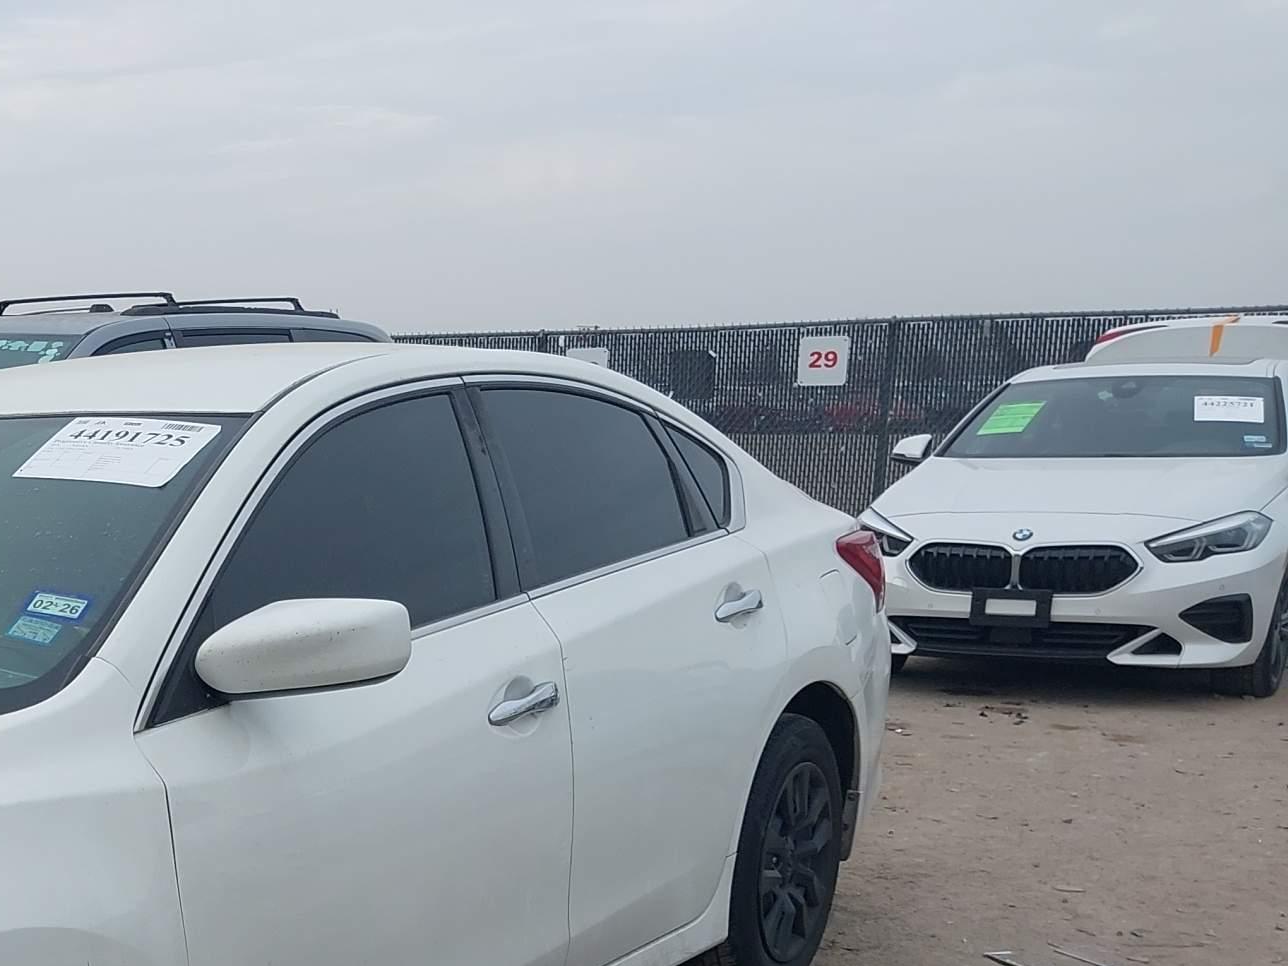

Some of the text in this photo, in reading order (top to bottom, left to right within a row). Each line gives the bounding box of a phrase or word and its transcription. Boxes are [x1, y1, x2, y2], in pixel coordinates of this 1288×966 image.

[808, 351, 838, 369] 29
[69, 429, 190, 447] 44191725
[32, 599, 54, 611] 02
[58, 603, 80, 615] 26
